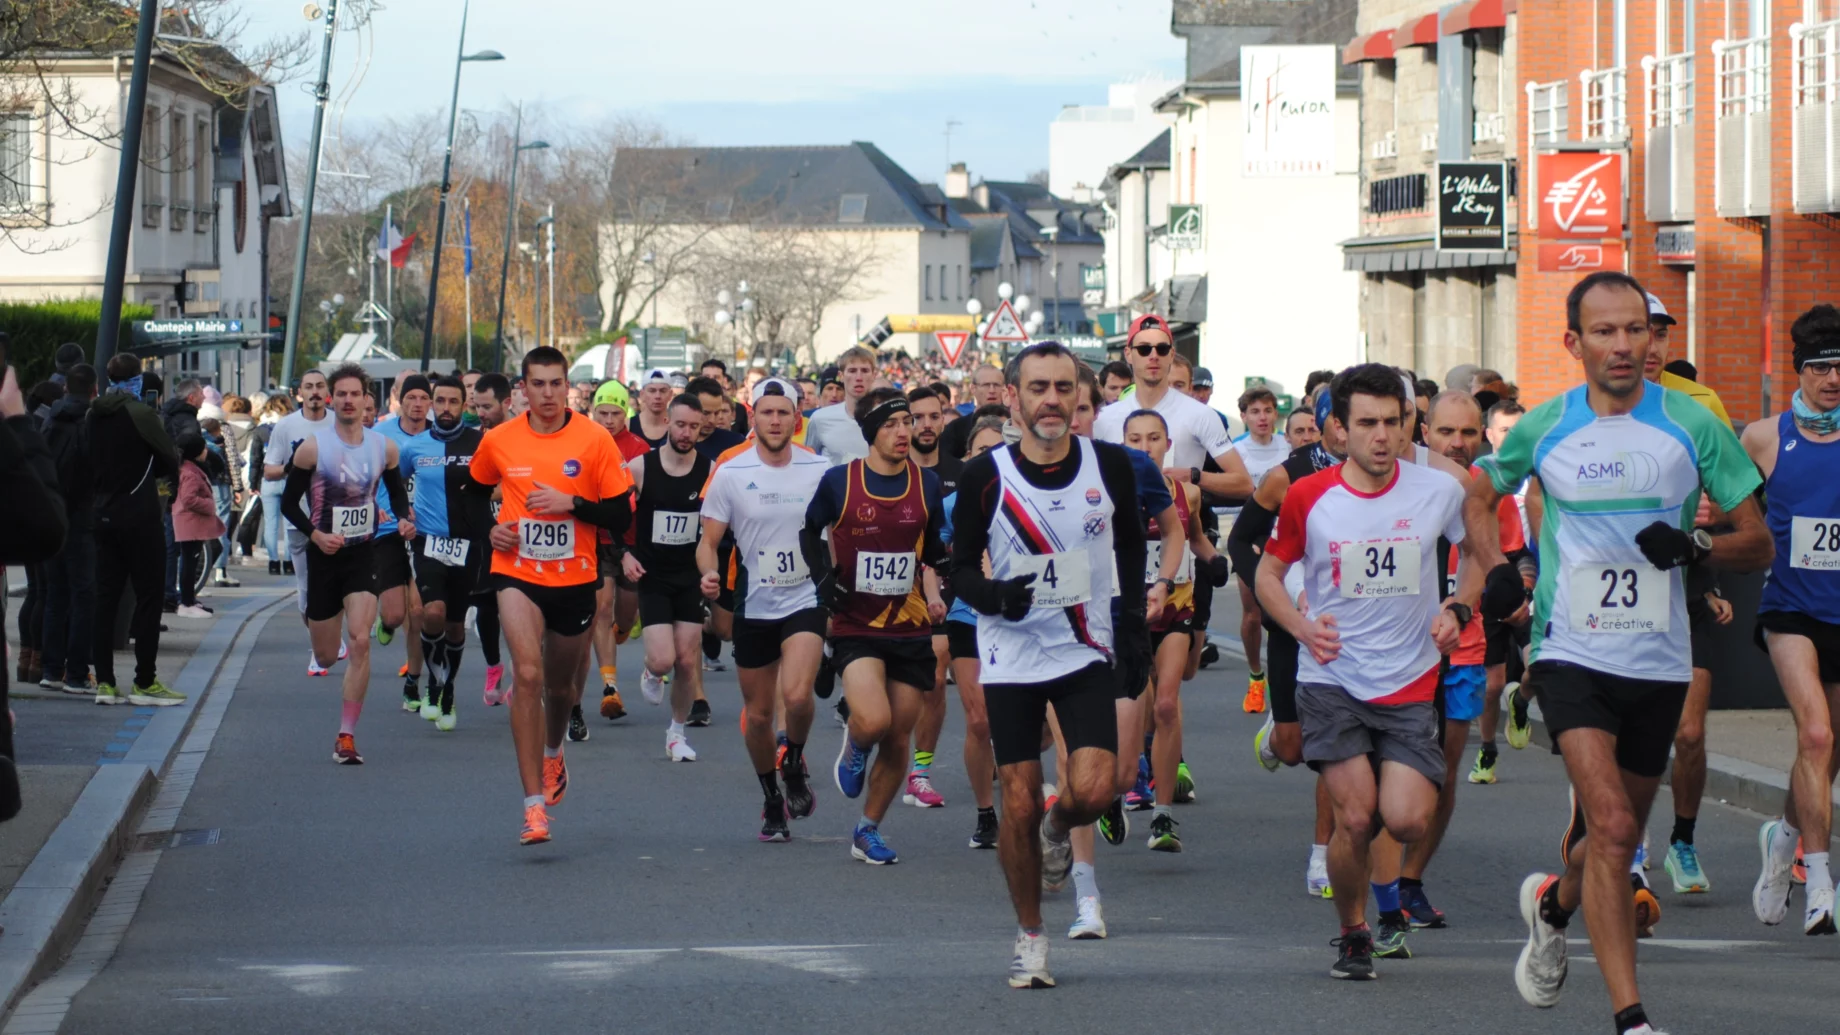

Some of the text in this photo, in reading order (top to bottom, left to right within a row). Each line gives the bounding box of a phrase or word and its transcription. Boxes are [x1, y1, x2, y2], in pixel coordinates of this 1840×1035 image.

[144, 320, 226, 334] Chantepie Mairie
[1072, 336, 1103, 349] Mairie
[417, 455, 457, 467] ESCAP
[1576, 461, 1626, 480] ASMR
[340, 508, 368, 527] 209
[665, 515, 688, 534] 177
[524, 522, 568, 547] 1296
[1812, 522, 1840, 552] 28
[431, 535, 463, 558] 1395
[776, 551, 796, 573] 31
[864, 556, 909, 581] 1542
[1365, 547, 1397, 578] 34
[1042, 558, 1059, 589] 4
[1365, 584, 1408, 595] créative
[1600, 568, 1638, 609] 23
[1037, 594, 1081, 606] créative
[1601, 618, 1654, 630] créative
